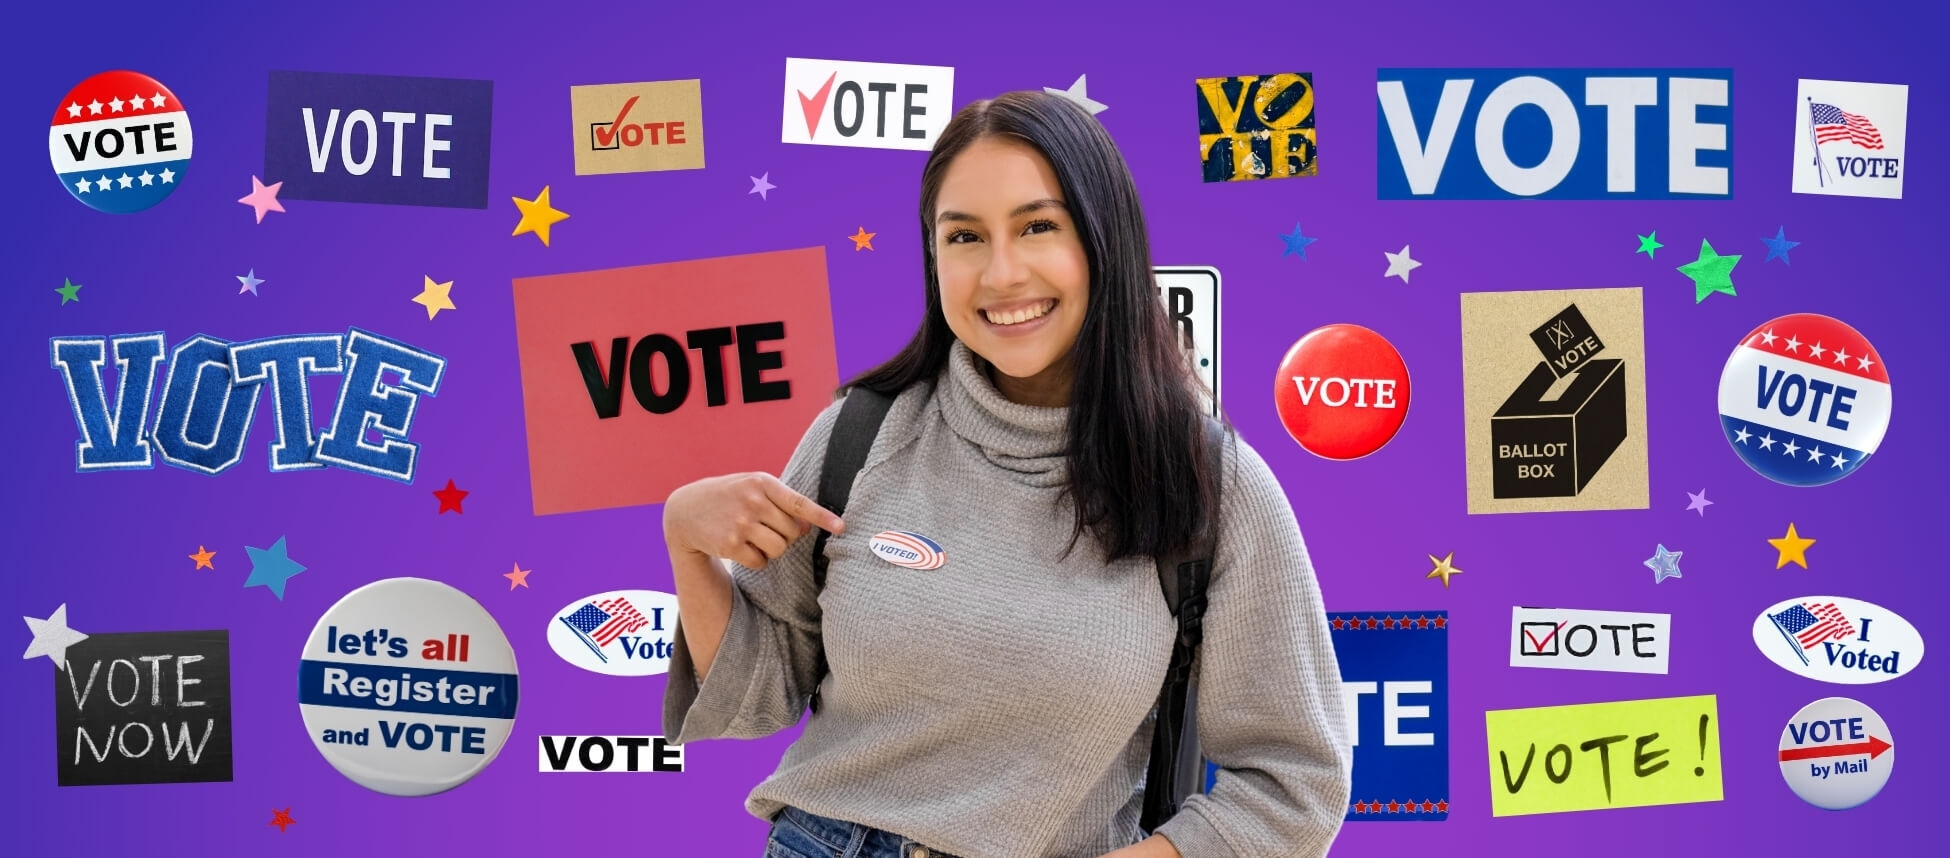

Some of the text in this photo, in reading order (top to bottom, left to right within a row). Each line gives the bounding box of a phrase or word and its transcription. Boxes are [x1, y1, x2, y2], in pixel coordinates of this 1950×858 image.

[63, 121, 177, 162] VOTE
[302, 107, 453, 179] VOTE
[1378, 76, 1729, 196] VOTE
[1836, 157, 1899, 179] VOTE
[571, 321, 792, 419] VOTE
[1555, 336, 1599, 370] VOTE
[50, 326, 447, 485] VOTE
[1292, 376, 1396, 409] VOTE
[1756, 364, 1857, 431] VOTE
[1499, 443, 1567, 459] BALLOT
[1518, 464, 1555, 479] BOX
[873, 542, 879, 550] I
[651, 608, 664, 631] I
[1857, 617, 1872, 642] I
[327, 625, 470, 663] let's all
[618, 636, 675, 659] Vote
[1822, 641, 1900, 674] Voted
[65, 654, 206, 711] VOTE
[323, 667, 496, 707] Register
[1342, 680, 1435, 747] TE
[1788, 717, 1865, 745] VOTE
[74, 718, 214, 765] NOW
[322, 720, 486, 755] and VOTE
[541, 736, 682, 772] VOTE
[1810, 758, 1868, 780] by Mail
